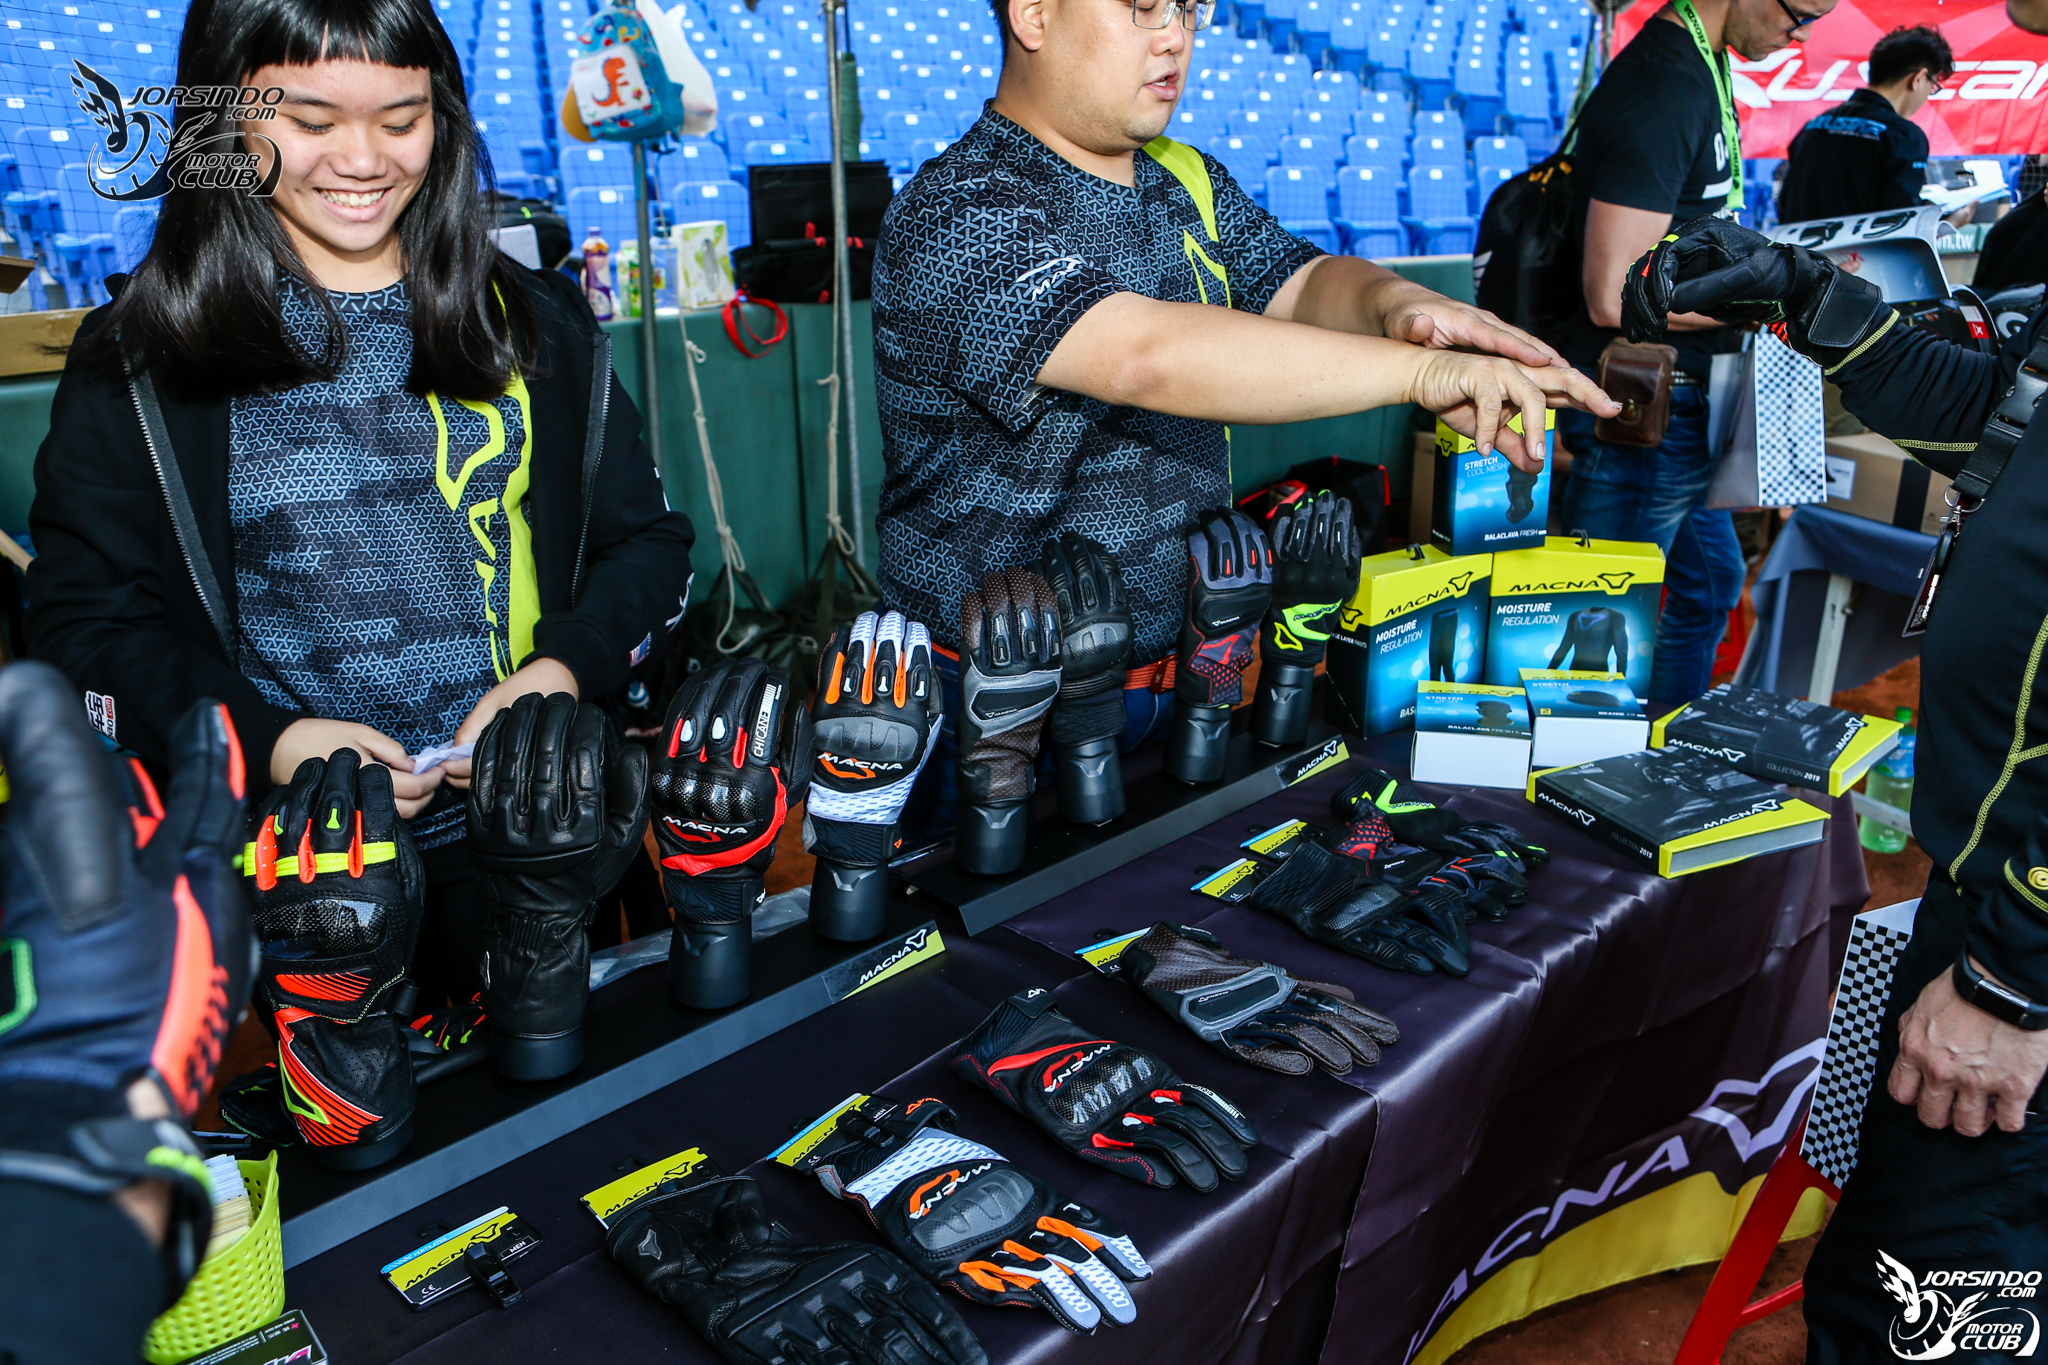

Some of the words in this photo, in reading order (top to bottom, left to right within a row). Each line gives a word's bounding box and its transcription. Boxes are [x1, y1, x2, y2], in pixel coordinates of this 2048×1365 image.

[1464, 456, 1498, 470] STRETCH
[1467, 467, 1486, 477] COOL
[1486, 462, 1506, 474] MESH
[1484, 531, 1518, 541] BALACLAVA
[1520, 528, 1538, 536] FRESH
[1509, 580, 1600, 592] MACNA
[1385, 586, 1450, 618] MACNA
[1497, 602, 1552, 615] MOISTURE
[1502, 614, 1560, 626] REGULATION
[1341, 634, 1354, 644] LAYER
[1376, 619, 1418, 644] MOISTURE
[1380, 629, 1423, 654] REGULATION
[1400, 706, 1416, 718] BAS
[753, 711, 769, 757] CHICANE
[1836, 725, 1858, 750] MACNA
[1669, 738, 1724, 757] MACNA
[818, 753, 904, 771] MACNA
[1297, 752, 1329, 777] MACNA
[1766, 763, 1804, 778] COLLECTION
[1803, 771, 1821, 783] 2019
[1538, 792, 1580, 819] MACNA
[662, 815, 748, 835] MACNA
[1704, 806, 1764, 829] MACNA
[1263, 833, 1293, 853] MACNA
[1611, 831, 1640, 853] COLLECTION
[1639, 846, 1653, 859] 2019
[1216, 873, 1245, 896] MACNA
[860, 946, 911, 984] MACNA
[1097, 951, 1121, 965] MAC
[1044, 1043, 1111, 1093] MACNA
[604, 1176, 671, 1216] MACNA
[909, 1162, 992, 1220] MACNA
[413, 1236, 447, 1257] VENTILATED
[509, 1241, 526, 1254] MEN
[405, 1241, 477, 1289] MACNA
[421, 1284, 437, 1295] CE
